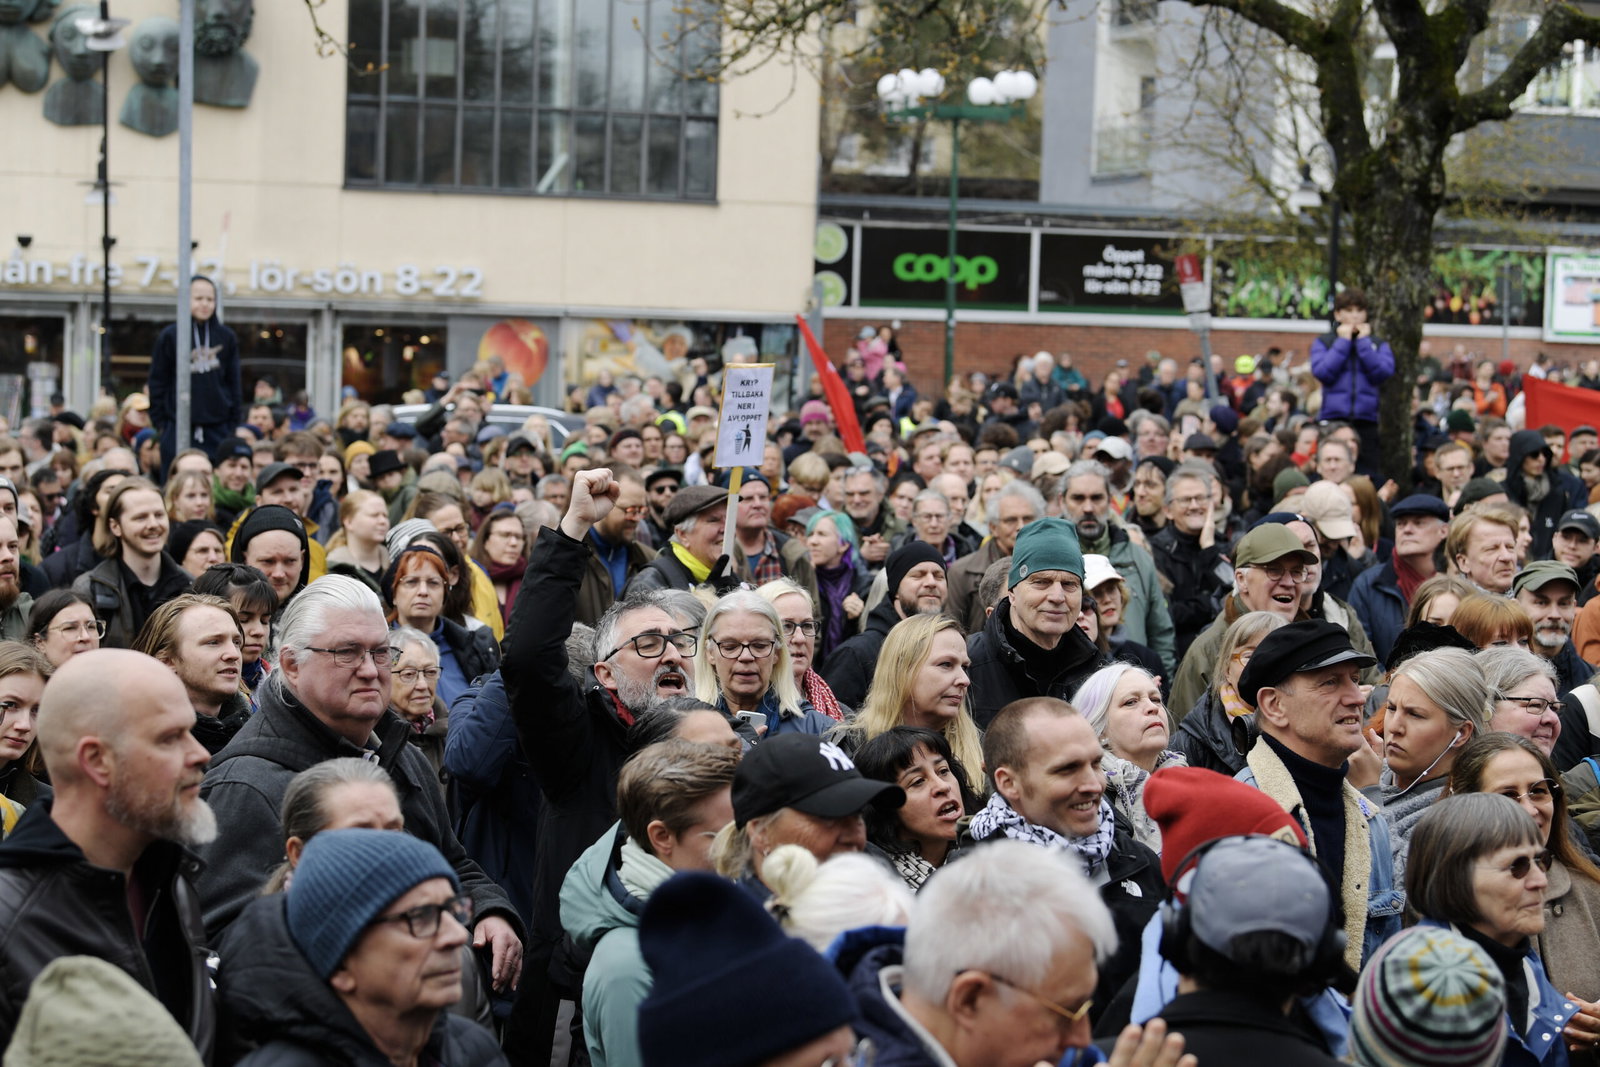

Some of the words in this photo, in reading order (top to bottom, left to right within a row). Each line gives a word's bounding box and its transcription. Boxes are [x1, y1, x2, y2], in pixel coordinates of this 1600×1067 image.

[0, 249, 124, 287] ån-fre
[250, 258, 382, 294] lör-sön
[394, 263, 484, 297] 8-22
[893, 253, 998, 290] coop
